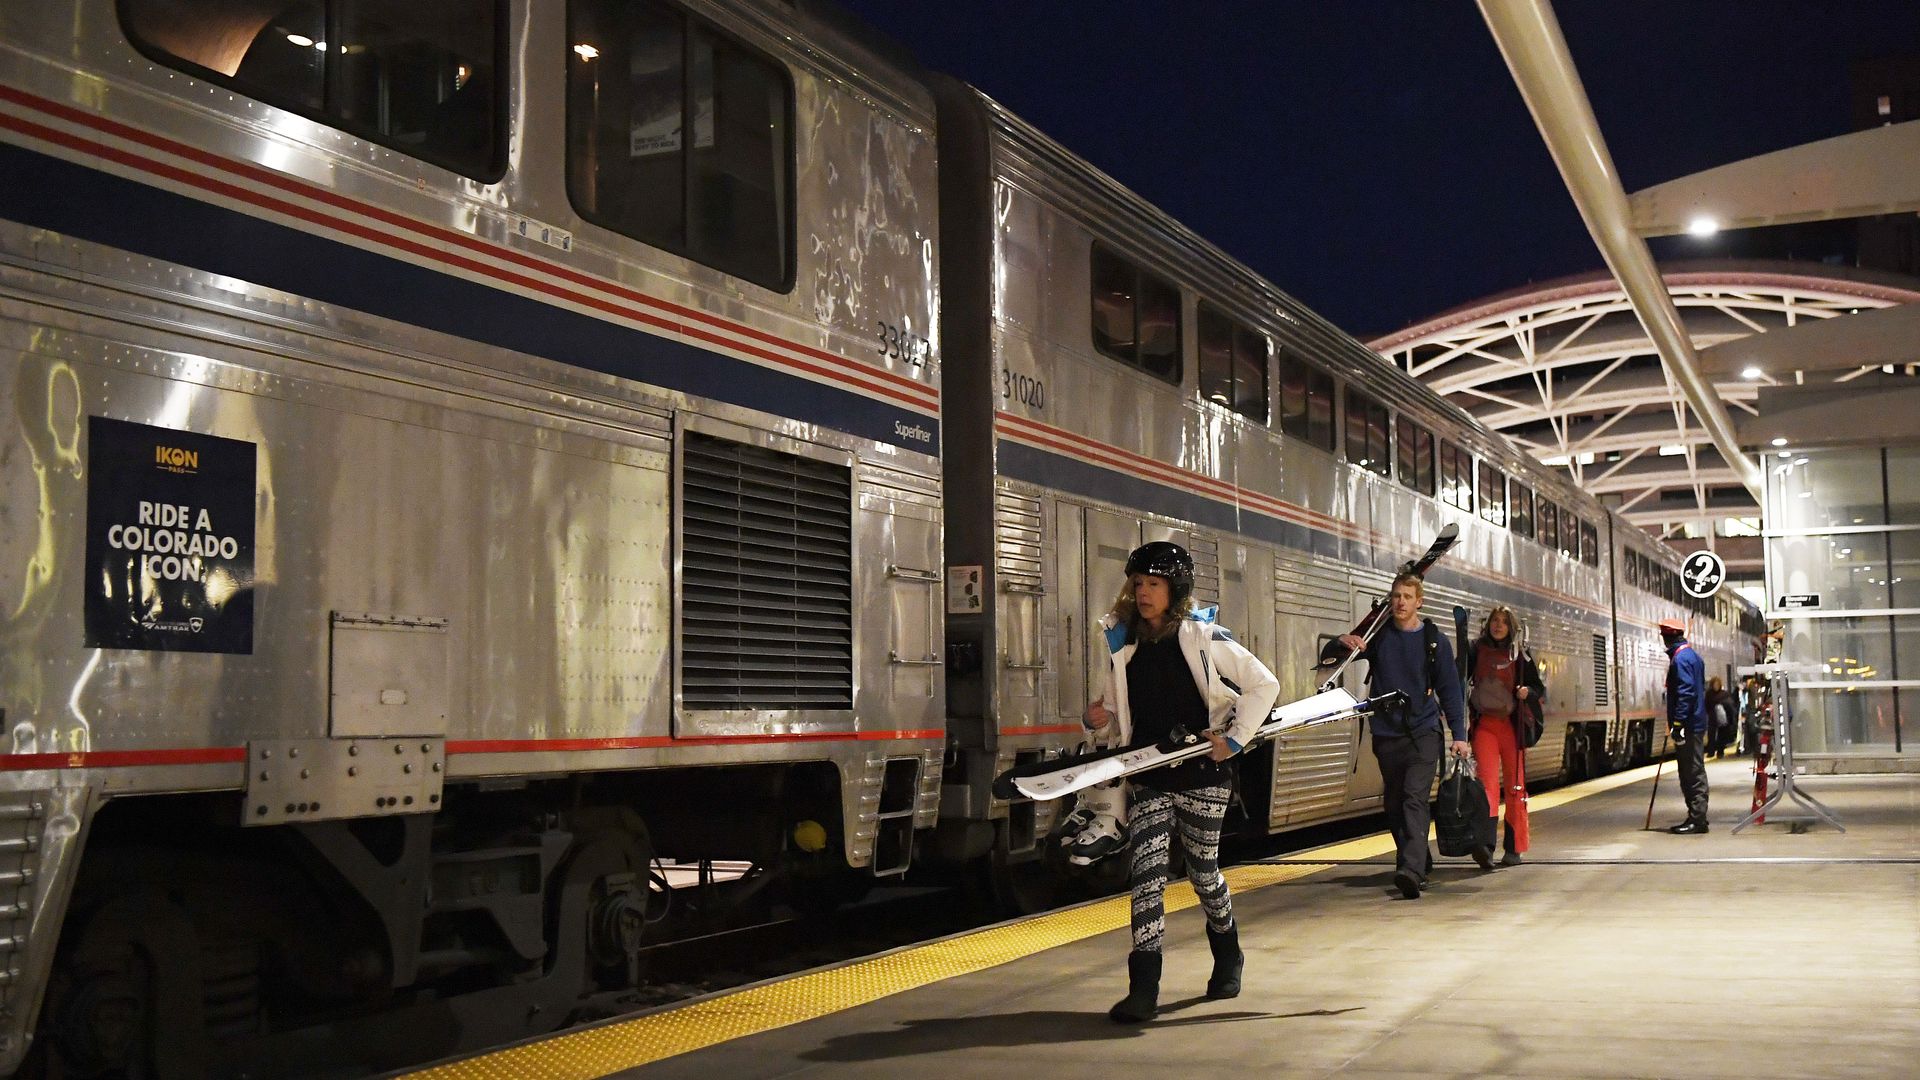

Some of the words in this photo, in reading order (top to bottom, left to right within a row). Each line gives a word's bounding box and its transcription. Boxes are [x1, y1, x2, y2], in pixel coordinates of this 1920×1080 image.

[1003, 369, 1044, 409] 31020
[894, 420, 931, 443] Superliner
[156, 446, 198, 468] IKON
[139, 501, 189, 529] RIDE
[194, 508, 212, 532] A
[108, 524, 238, 560] COLORADO
